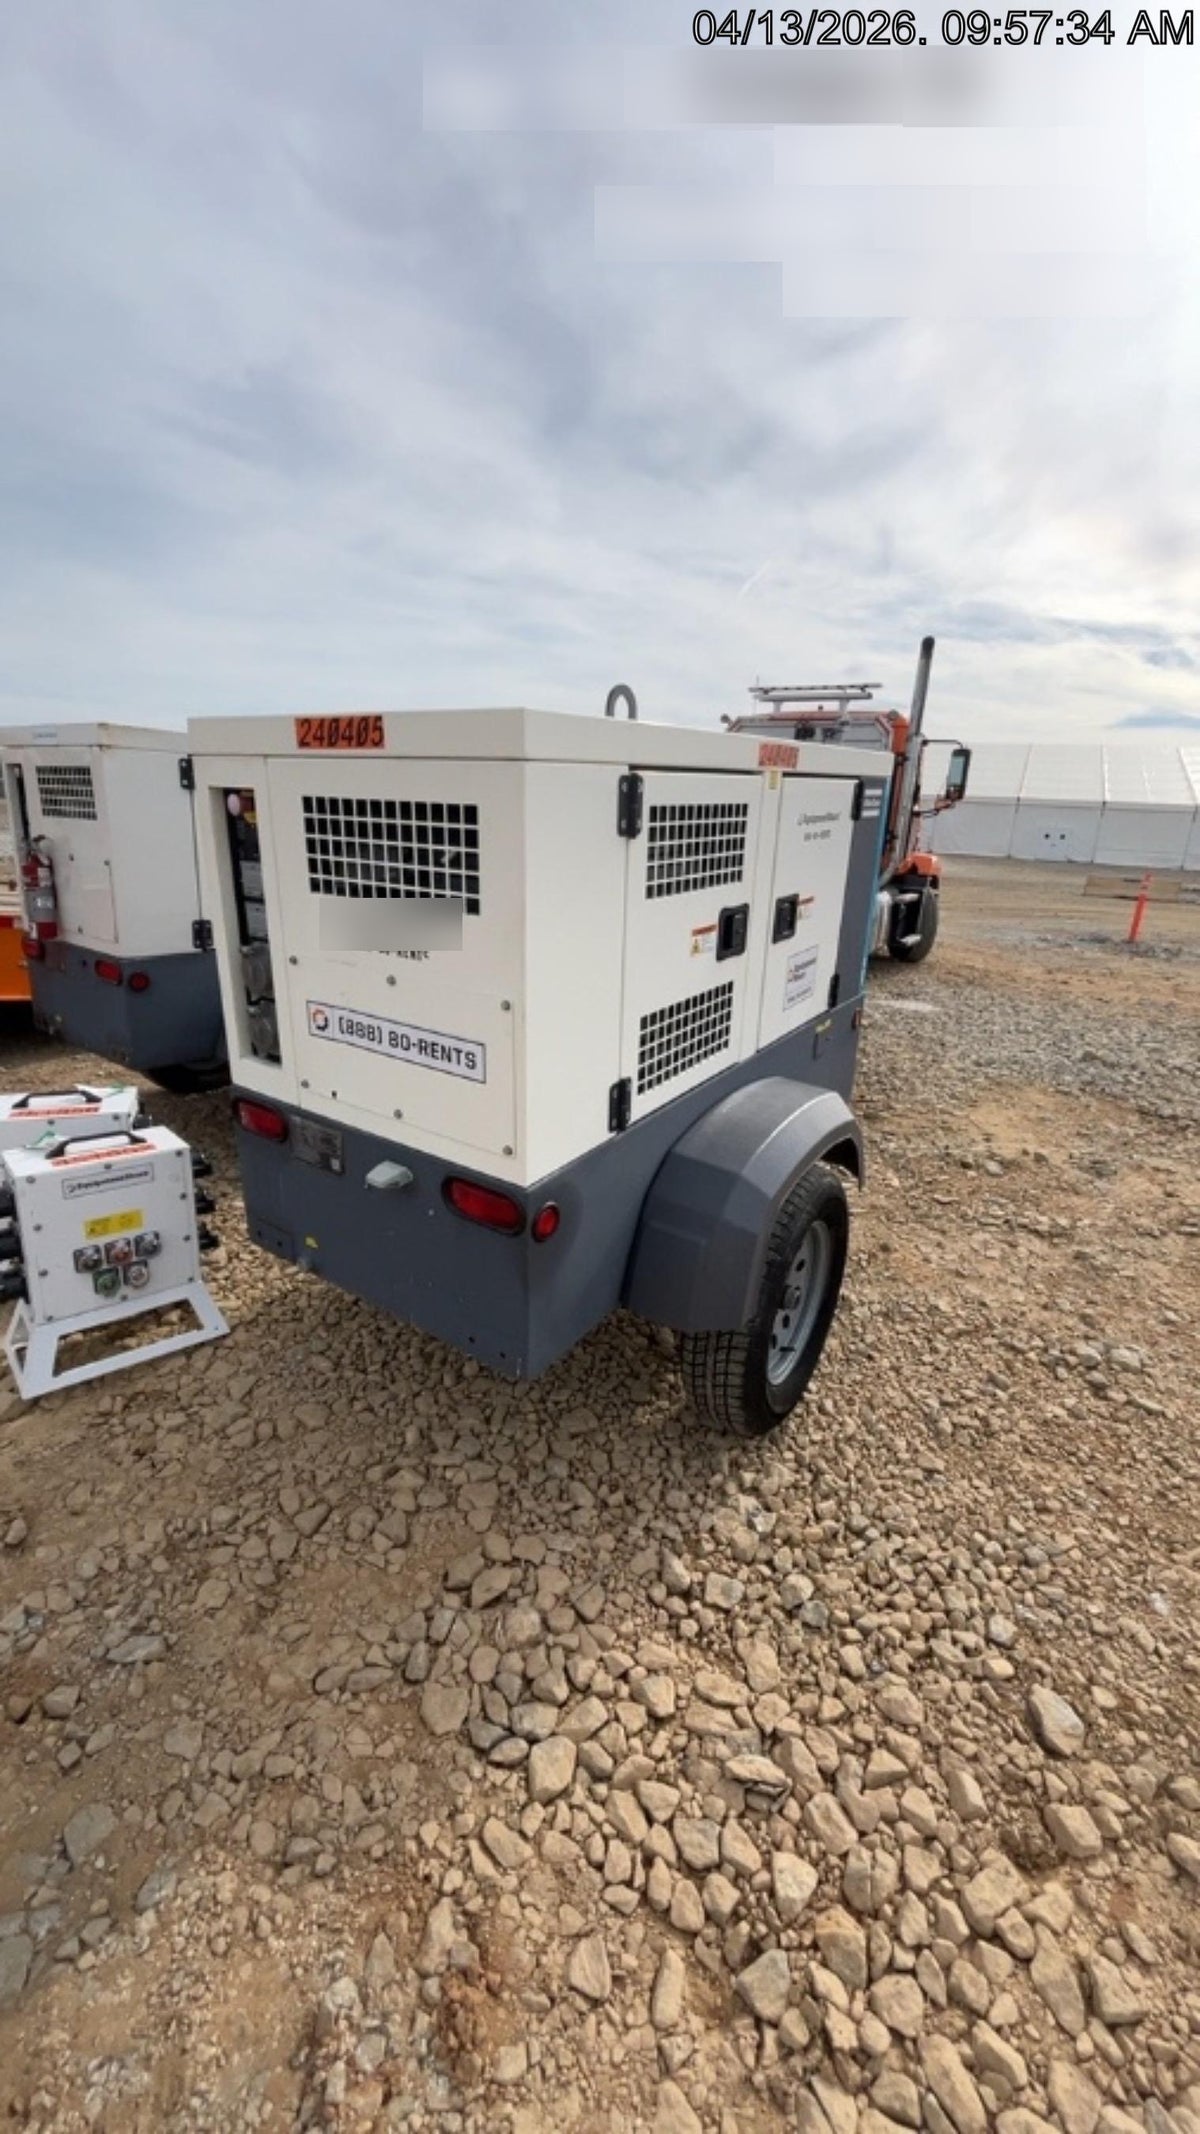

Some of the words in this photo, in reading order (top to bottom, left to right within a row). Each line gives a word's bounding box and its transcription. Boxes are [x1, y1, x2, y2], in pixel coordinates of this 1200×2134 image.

[299, 716, 385, 748] 240405
[338, 1016, 383, 1045] (888)
[388, 1030, 478, 1071] 80-RENTS
